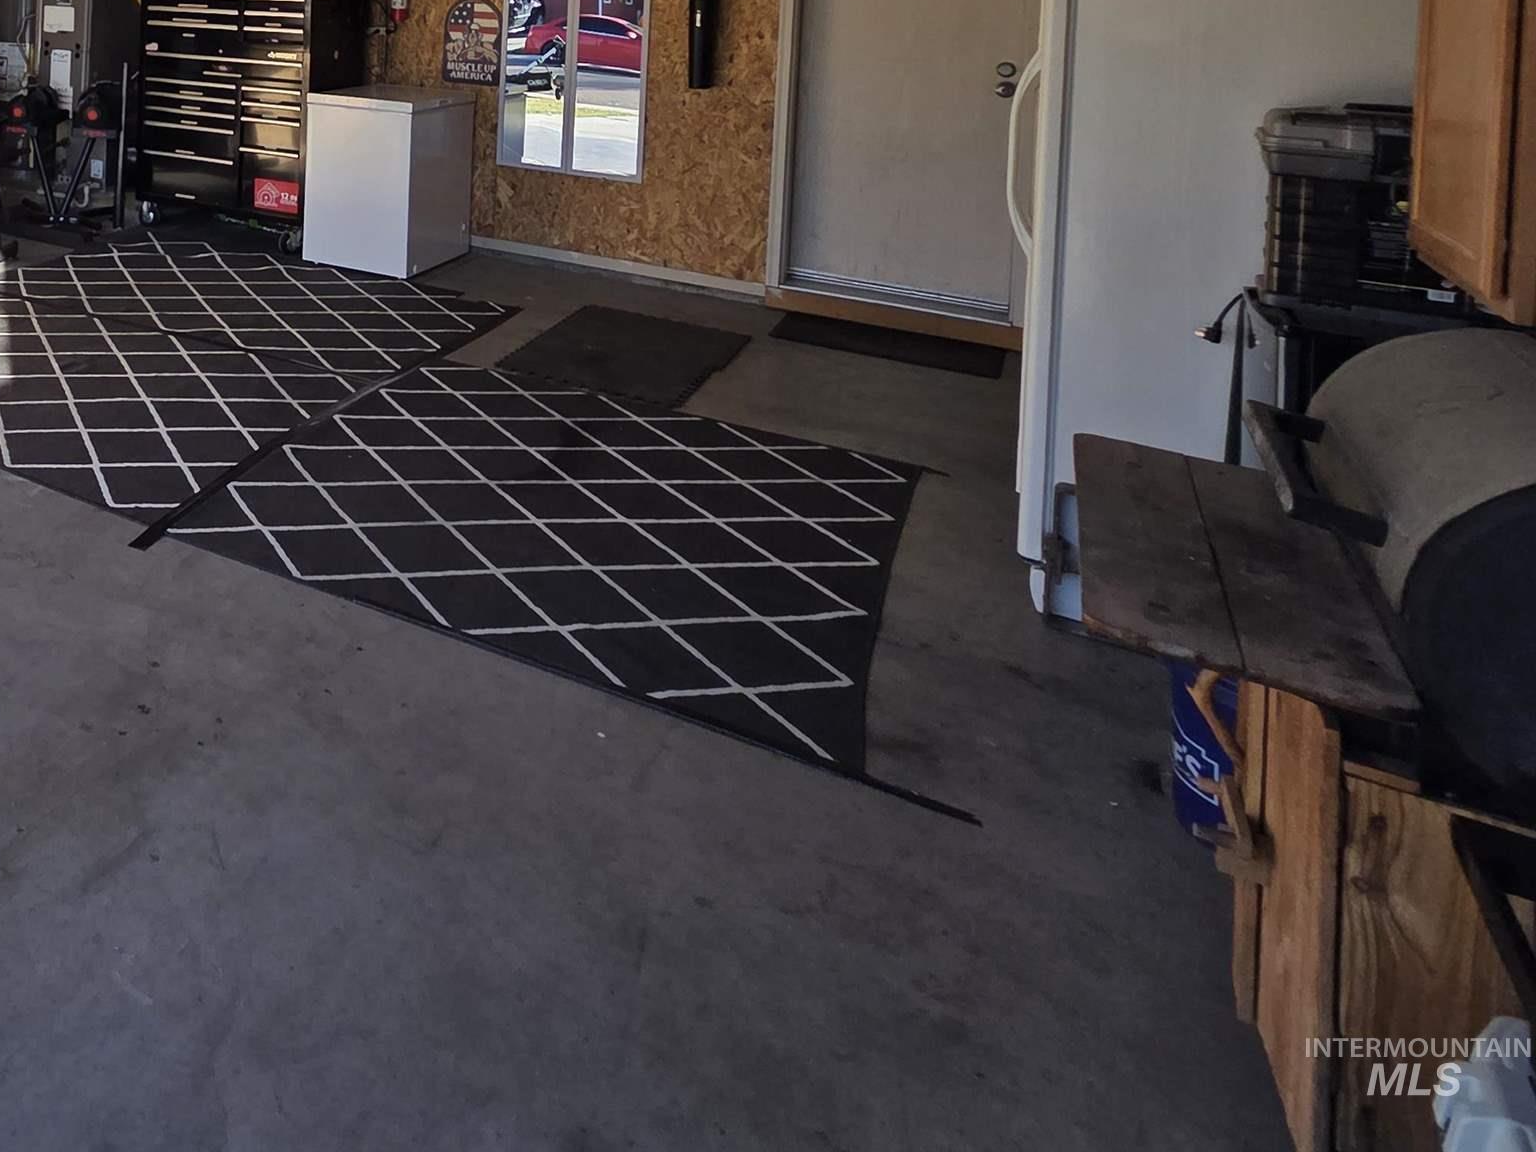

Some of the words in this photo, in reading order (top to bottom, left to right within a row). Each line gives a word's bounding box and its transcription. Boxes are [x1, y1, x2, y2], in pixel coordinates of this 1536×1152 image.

[447, 61, 483, 73] MUSCLE
[484, 64, 497, 74] UP
[449, 71, 493, 82] AMERICA
